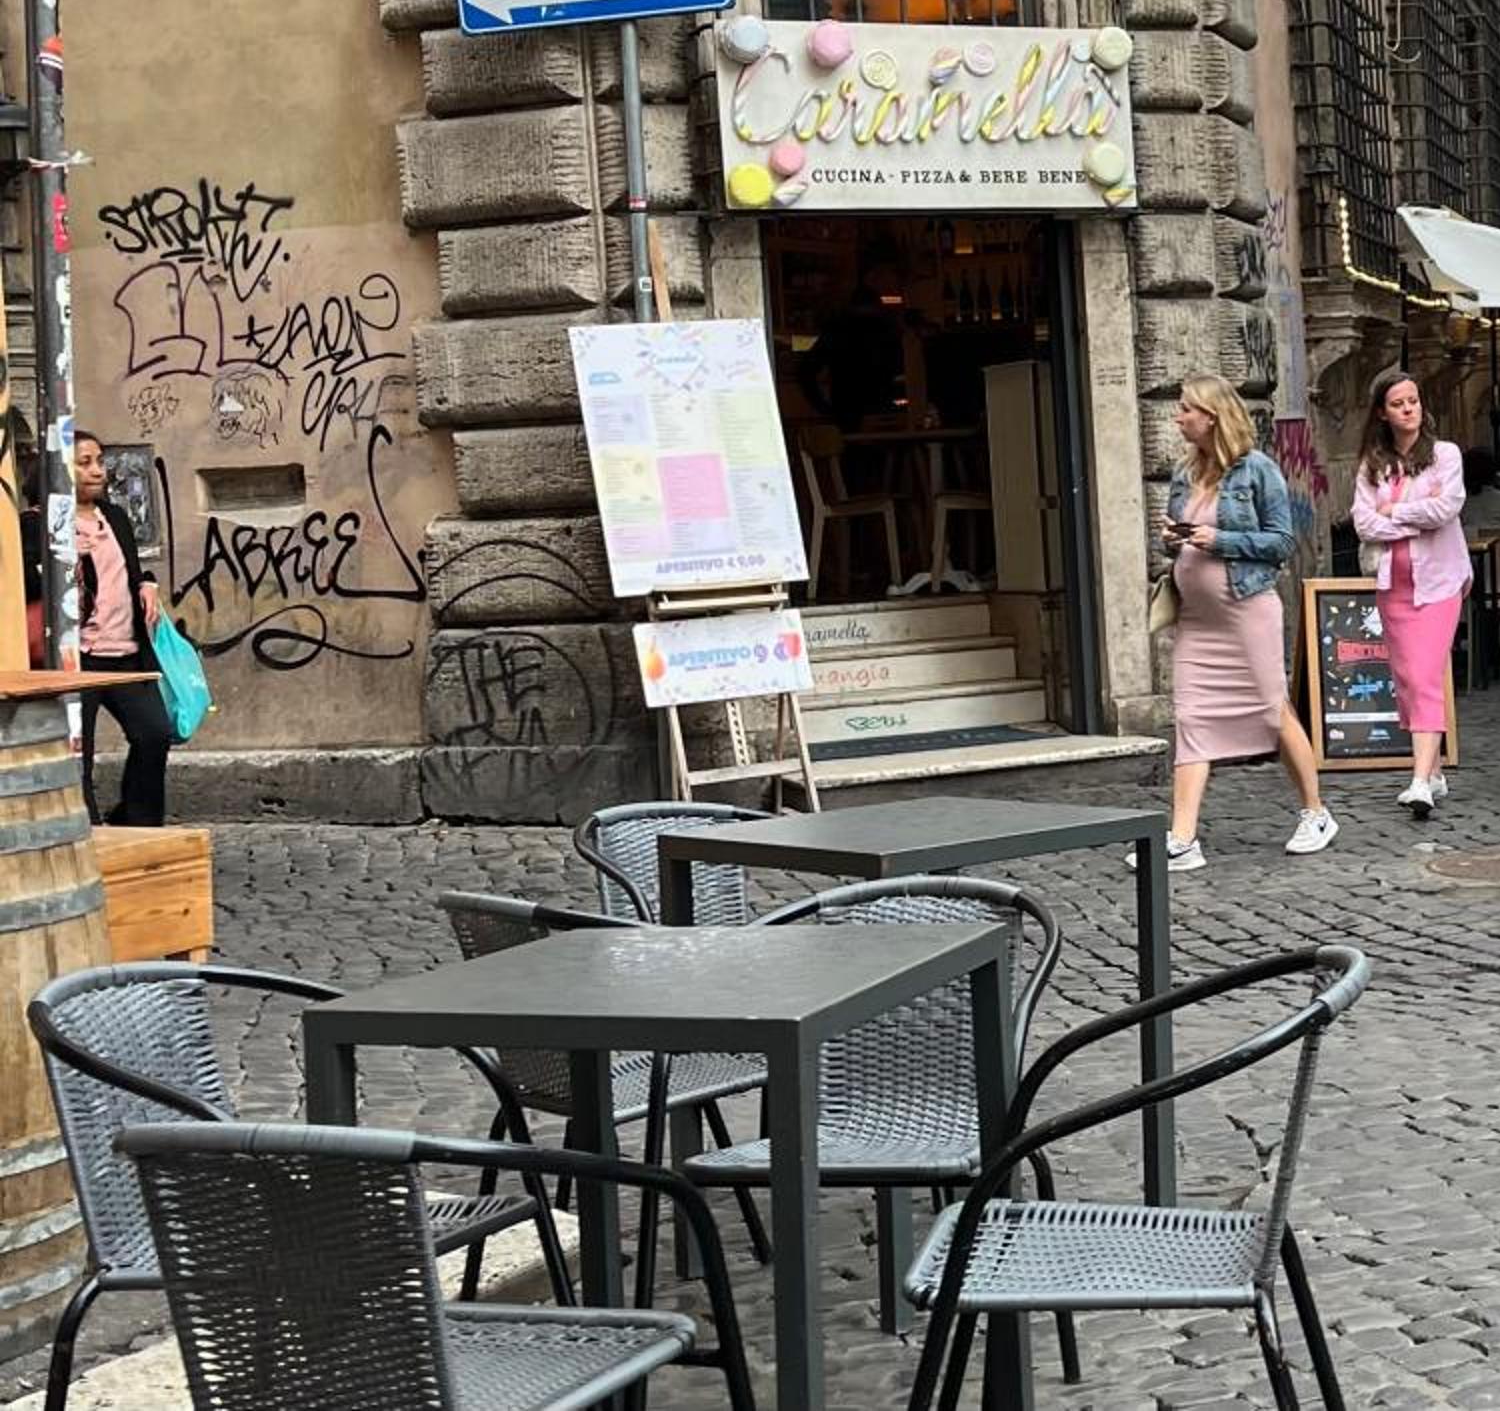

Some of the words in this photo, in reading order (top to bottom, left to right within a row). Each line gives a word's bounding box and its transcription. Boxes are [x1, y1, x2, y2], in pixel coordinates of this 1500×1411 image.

[732, 38, 1121, 144] Caramella
[811, 169, 885, 184] CUCINA
[900, 169, 956, 185] PIZZA
[980, 169, 1028, 184] BERE
[1038, 169, 1088, 185] BENE
